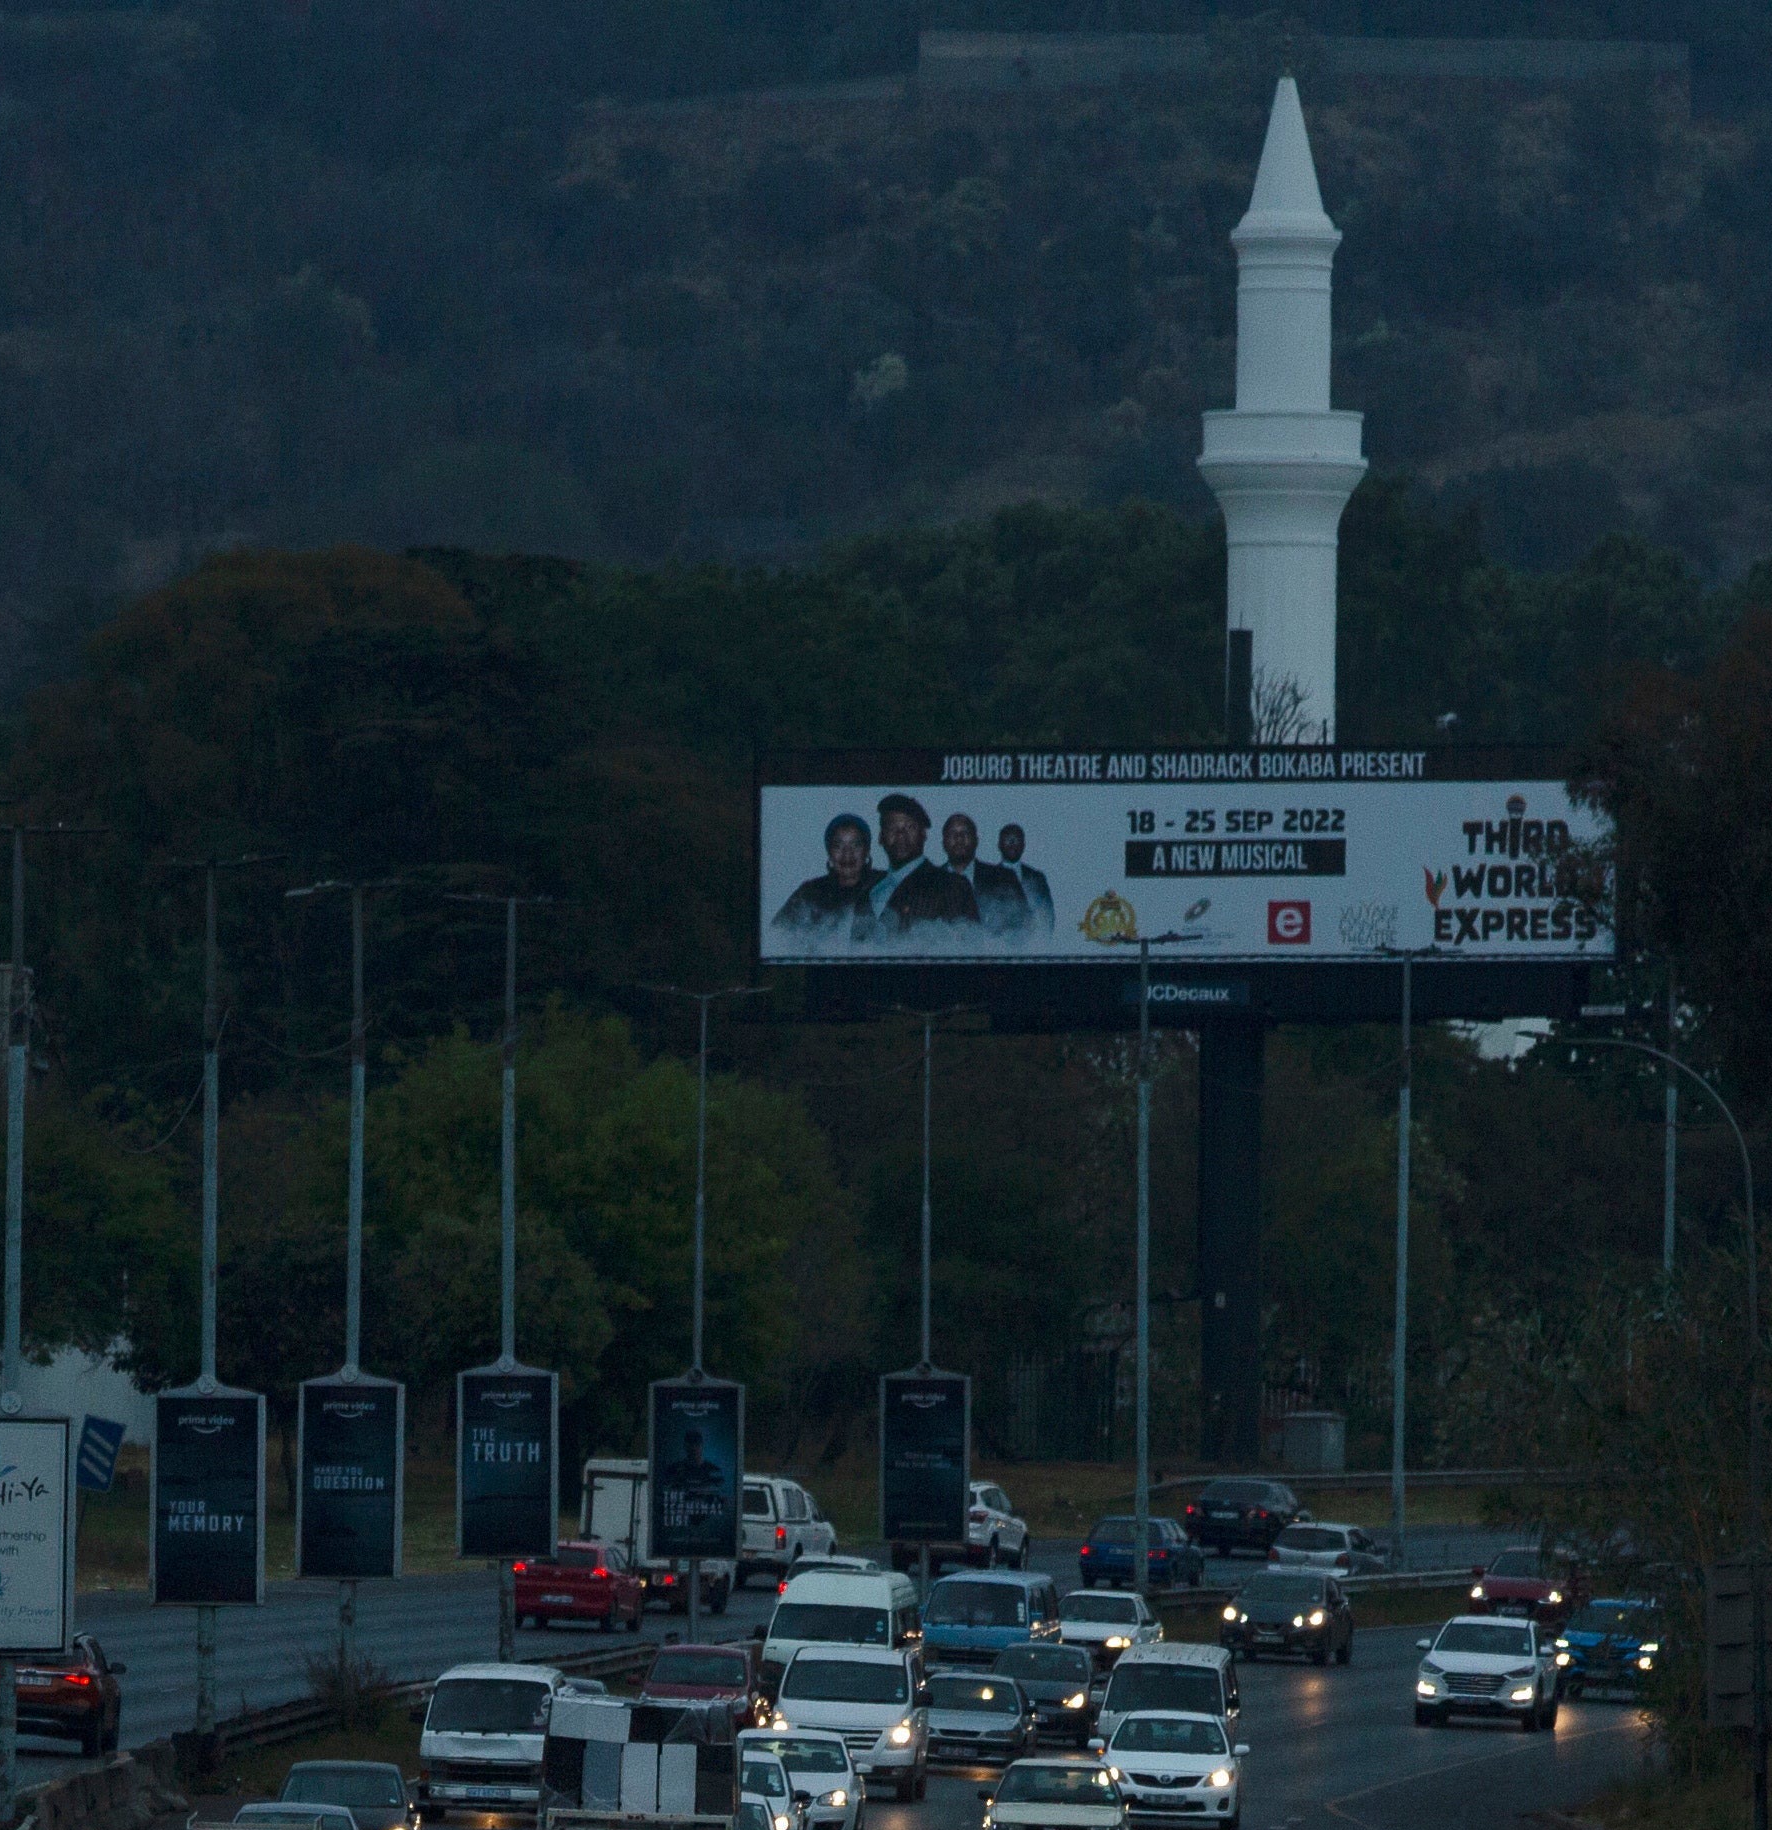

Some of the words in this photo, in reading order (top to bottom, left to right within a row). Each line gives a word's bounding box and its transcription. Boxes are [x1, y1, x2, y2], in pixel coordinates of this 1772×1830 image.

[940, 754, 1012, 781] JOBURG
[1017, 754, 1103, 780] THEATRE
[1106, 754, 1147, 779] AND
[1151, 753, 1254, 779] SHADRACK
[1258, 752, 1336, 779] BOKABA
[1341, 751, 1426, 778] PRESENT
[1127, 810, 1155, 834] 18
[1184, 809, 1216, 833] 25
[1225, 809, 1273, 833] SEP
[1282, 808, 1346, 832] 2022
[1462, 818, 1569, 859] THIRD
[1152, 845, 1166, 870] A
[1171, 845, 1216, 870] NEW
[1220, 844, 1309, 870] MUSICAL
[1434, 908, 1596, 944] EXPRESS
[472, 1427, 496, 1441] THE
[472, 1442, 541, 1463] TRUTH
[313, 1475, 385, 1490] QUESTION
[169, 1500, 206, 1514] YOUR
[168, 1514, 244, 1533] MEMORY
[18, 1605, 54, 1617] Power
